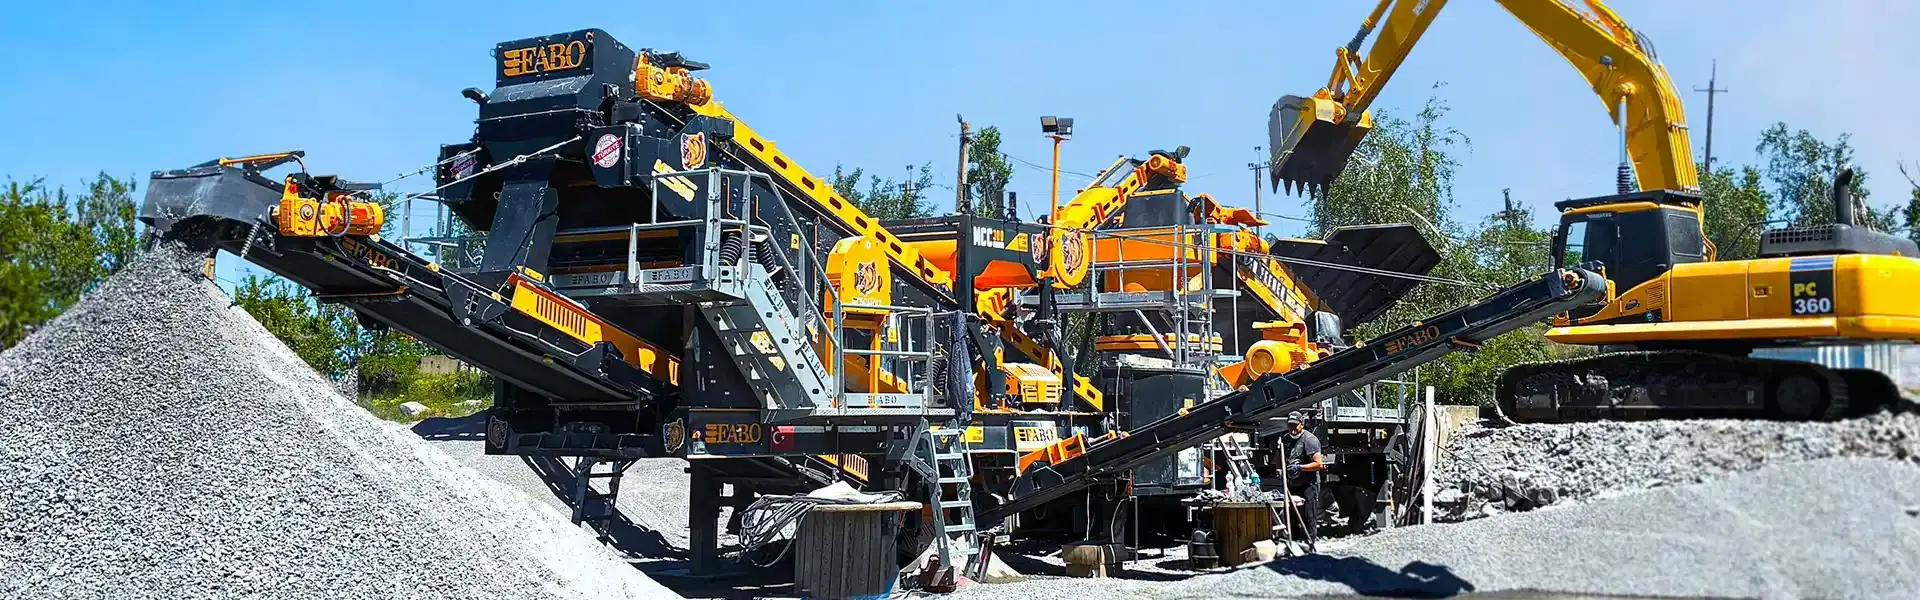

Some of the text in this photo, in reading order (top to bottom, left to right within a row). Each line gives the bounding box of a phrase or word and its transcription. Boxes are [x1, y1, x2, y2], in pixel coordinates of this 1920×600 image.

[520, 40, 586, 73] FABO
[973, 226, 993, 248] MCC
[577, 273, 607, 285] FABO
[657, 270, 689, 281] FABO
[1793, 282, 1817, 297] PC
[1794, 297, 1831, 314] 360
[1397, 325, 1440, 351] FABO
[717, 423, 762, 443] FABO
[1025, 428, 1054, 442] FABO
